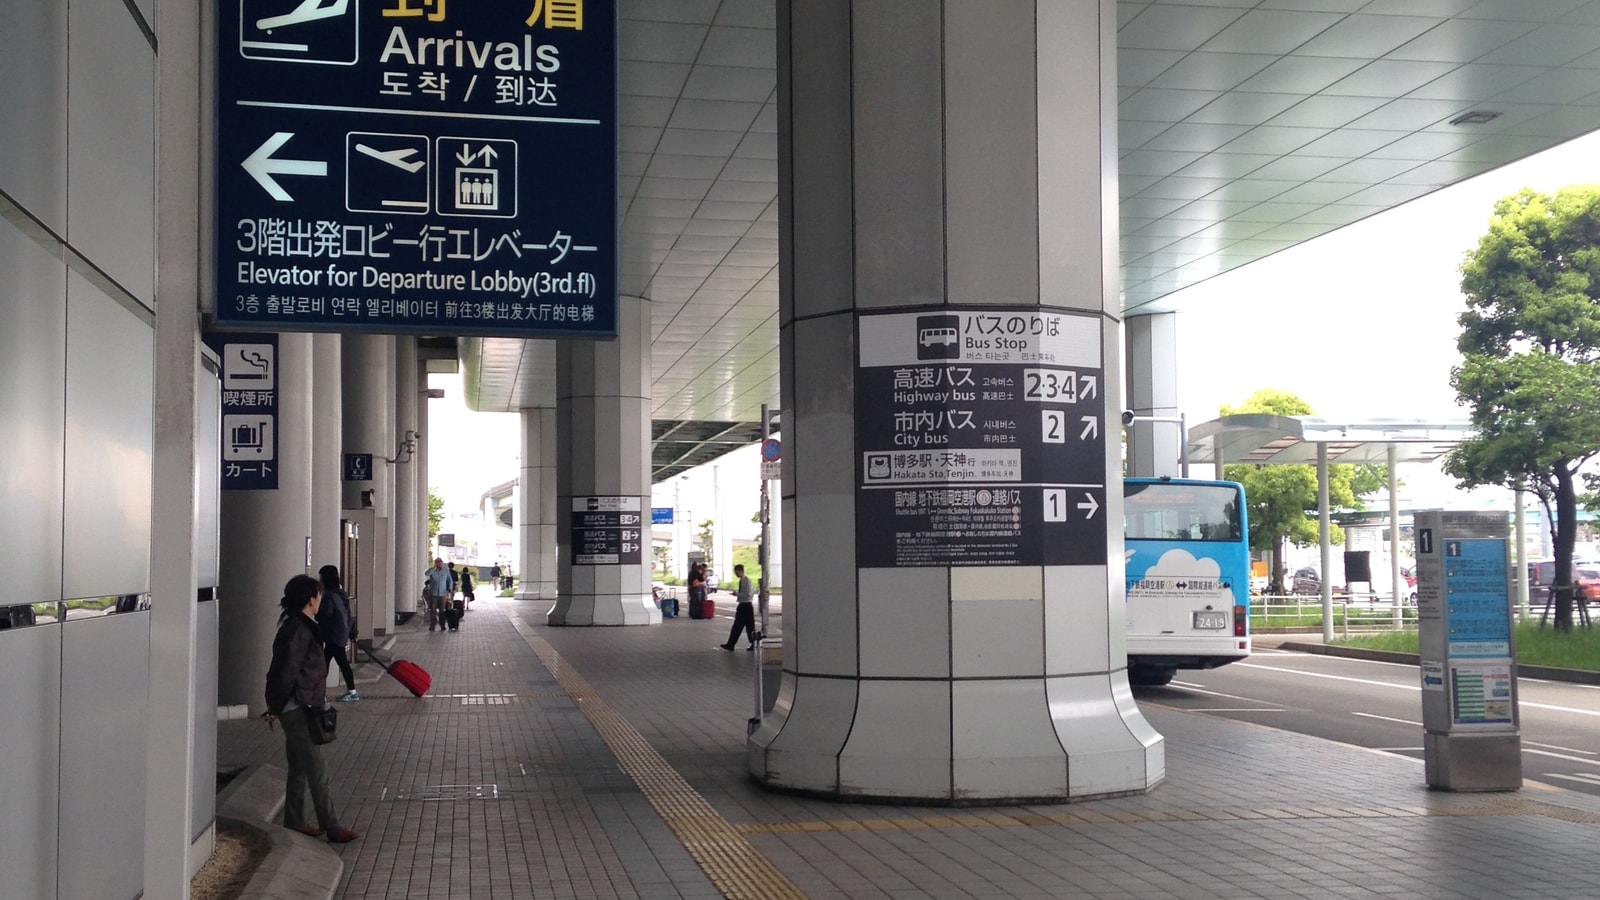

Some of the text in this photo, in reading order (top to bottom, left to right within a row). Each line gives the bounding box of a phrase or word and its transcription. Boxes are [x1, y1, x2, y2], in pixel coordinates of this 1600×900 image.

[380, 27, 561, 73] Arrivals
[379, 71, 559, 107] 도착 / 到达
[236, 218, 597, 265] 3階出発ロビー行エレベーター
[237, 261, 596, 298] Elevator for Departure Lobby(3rd.fl)
[235, 295, 595, 323] 3층 출발로비 연락 엘리베이터 前往3楼出发大厅的电梯
[964, 315, 1061, 337] バスのりば
[966, 337, 1027, 351] Bus Stop
[966, 352, 983, 360] 버스
[893, 366, 975, 390] 高速バス
[223, 391, 274, 407] 喫煙所
[894, 391, 949, 405] Highway
[952, 389, 976, 401] bus
[893, 409, 977, 432] 市内バス
[1047, 414, 1060, 440] 2
[893, 433, 920, 448] City
[924, 433, 949, 445] bus
[225, 463, 272, 478] カート
[893, 471, 926, 479] Hakata
[1048, 493, 1059, 518] 1
[1422, 531, 1429, 552] 1
